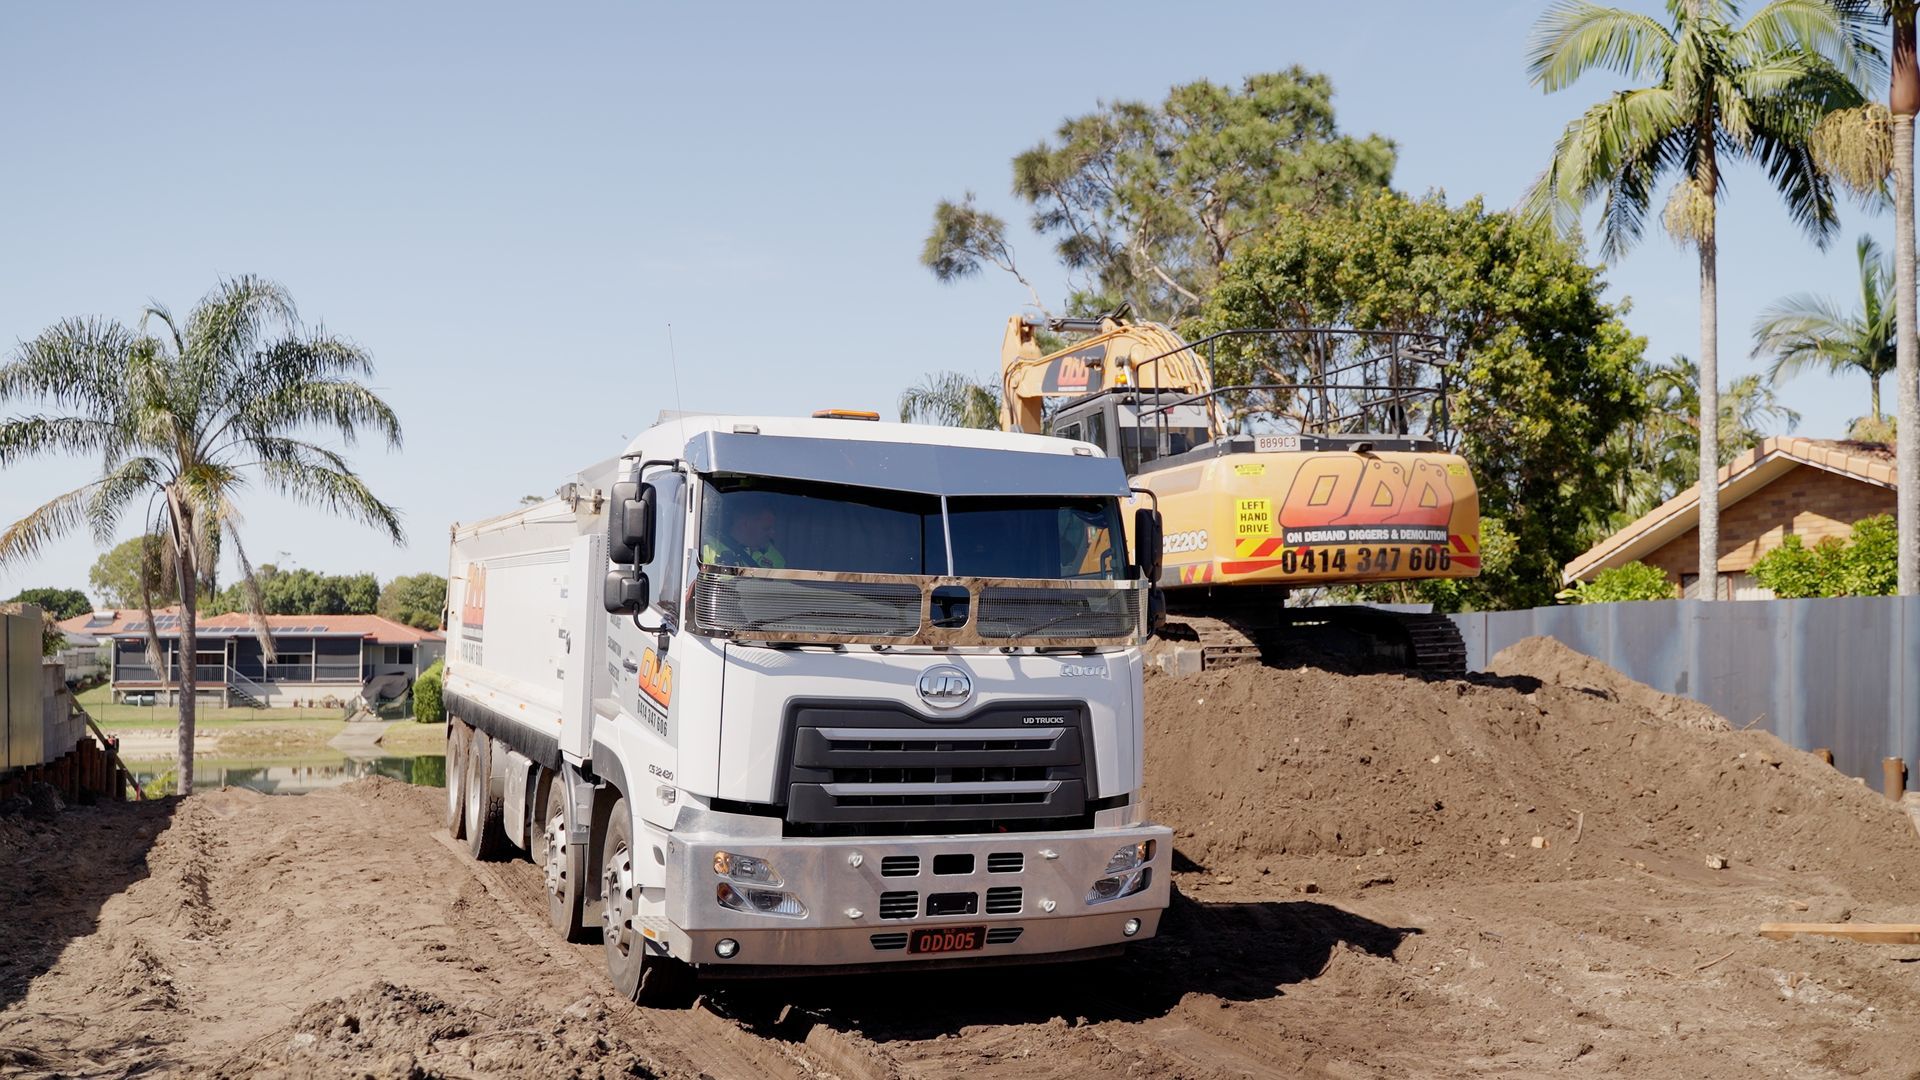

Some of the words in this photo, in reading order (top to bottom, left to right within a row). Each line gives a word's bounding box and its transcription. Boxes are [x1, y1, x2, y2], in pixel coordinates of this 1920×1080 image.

[1260, 436, 1297, 449] 8899C3
[1278, 456, 1454, 527] ODD
[1241, 501, 1265, 511] LEFT
[1240, 512, 1268, 522] HAND
[1239, 523, 1270, 534] DRIVE
[1162, 530, 1208, 554] X220C
[1286, 531, 1303, 544] ON
[1304, 530, 1347, 543] DEMAND
[1348, 529, 1390, 541] DIGGERS
[1391, 529, 1399, 540] &
[1400, 529, 1447, 541] DEMOLITION
[1281, 548, 1347, 575] 0414
[1356, 547, 1402, 573] 347
[1408, 547, 1451, 572] 606
[920, 676, 970, 698] UD
[647, 709, 657, 728] 347
[657, 716, 668, 737] 606
[1035, 716, 1065, 724] TRUCKS
